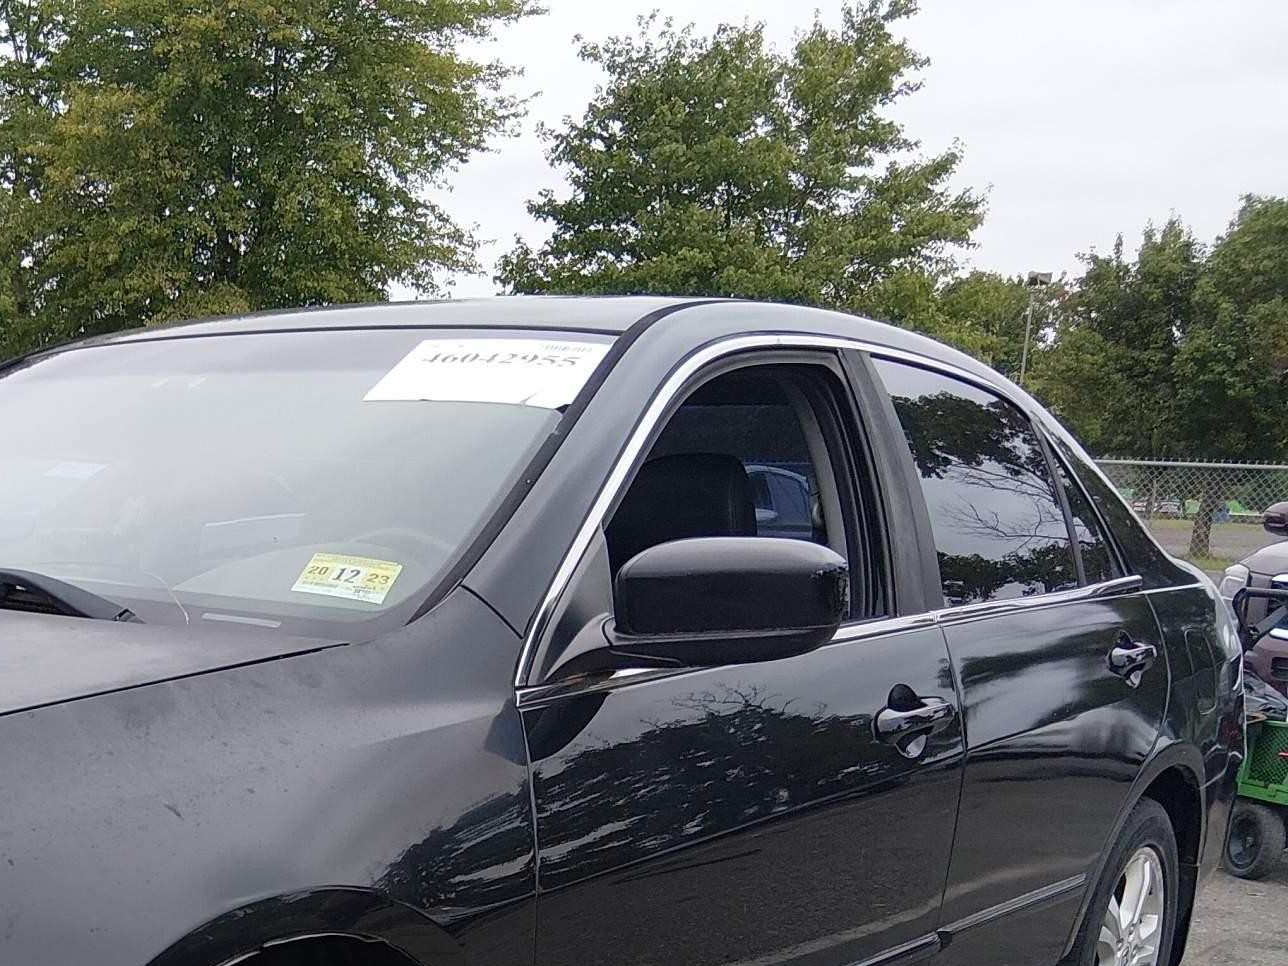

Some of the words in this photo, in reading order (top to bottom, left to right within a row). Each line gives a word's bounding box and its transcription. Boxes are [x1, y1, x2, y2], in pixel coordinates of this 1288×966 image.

[422, 352, 581, 367] 46042955
[308, 566, 329, 576] 20
[332, 567, 361, 583] 12
[367, 573, 390, 585] 23
